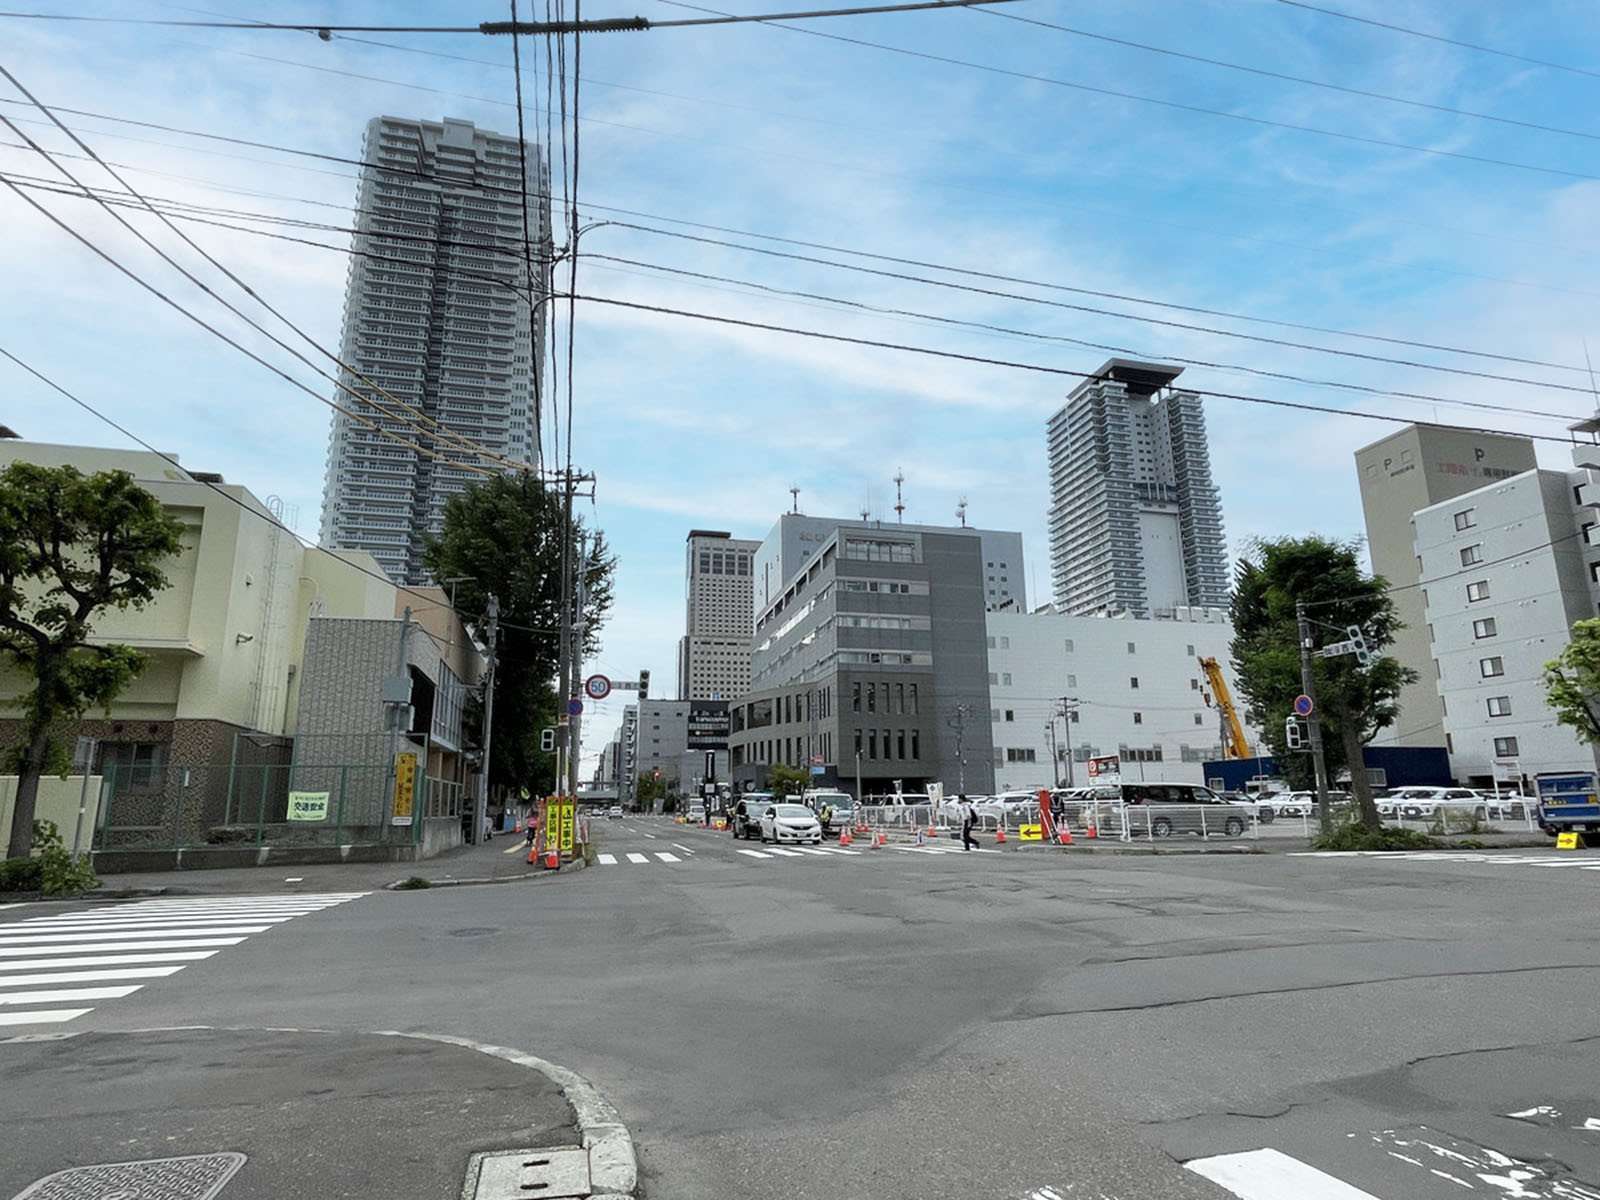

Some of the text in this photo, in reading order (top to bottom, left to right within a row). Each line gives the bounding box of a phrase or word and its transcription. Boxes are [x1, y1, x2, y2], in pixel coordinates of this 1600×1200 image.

[1474, 447, 1485, 462] P
[1384, 458, 1393, 470] P
[591, 680, 606, 693] 50
[294, 801, 325, 812] 交通安全
[562, 820, 572, 848] 工事中
